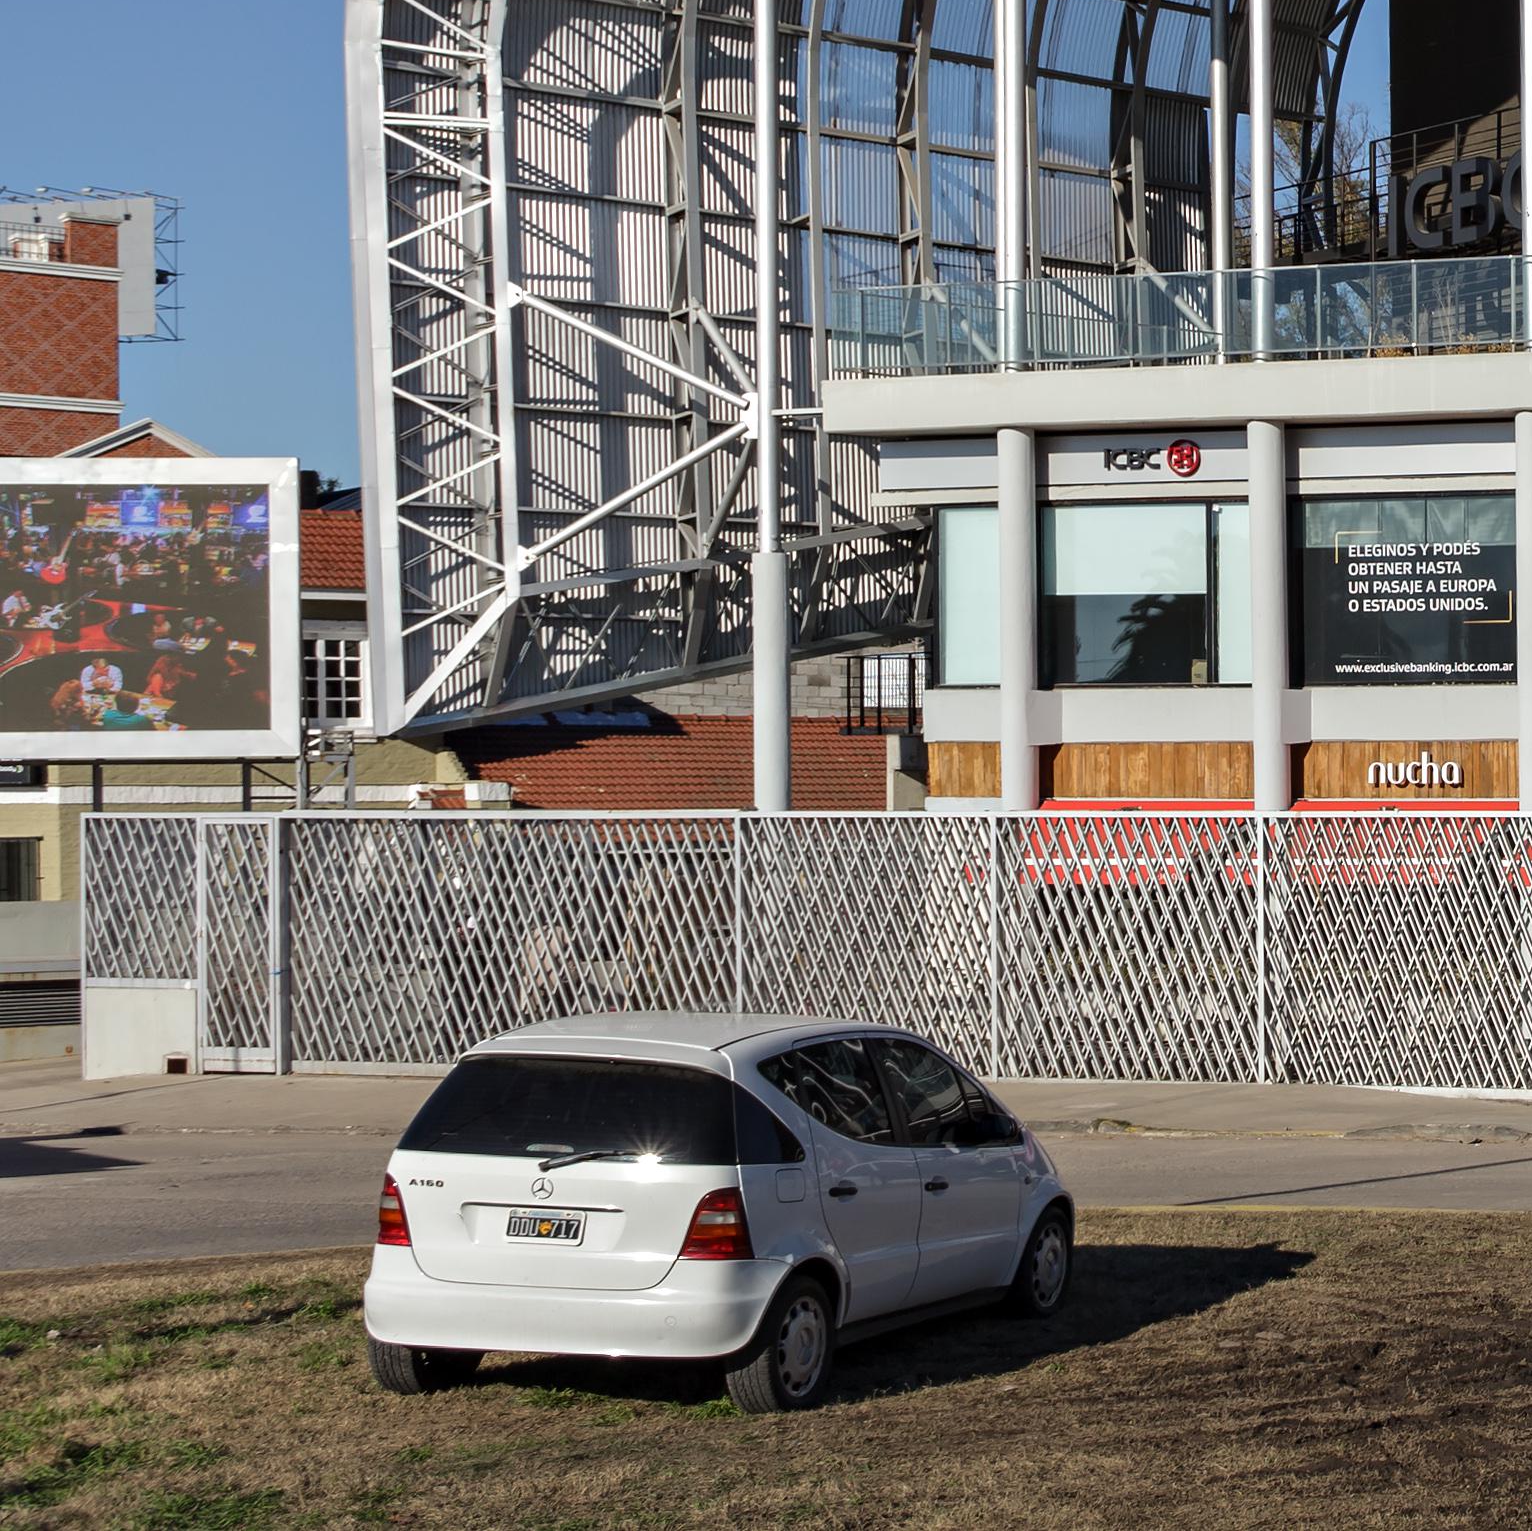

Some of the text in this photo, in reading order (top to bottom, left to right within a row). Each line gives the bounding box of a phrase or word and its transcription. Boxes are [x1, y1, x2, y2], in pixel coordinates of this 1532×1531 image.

[1103, 448, 1161, 471] ICBC
[1348, 540, 1481, 558] ELEGINOS Y PODÉS
[1348, 561, 1463, 576] OBTENER HASTA
[1348, 579, 1497, 595] UN PASAJE A EUROPA
[1348, 598, 1489, 612] O ESTADOS UNIDOS.
[1335, 661, 1514, 675] www.exclusivebanking.icbc.com.ar
[1367, 751, 1464, 788] nucha
[409, 1179, 444, 1188] A160
[509, 1217, 579, 1239] DDU 717
